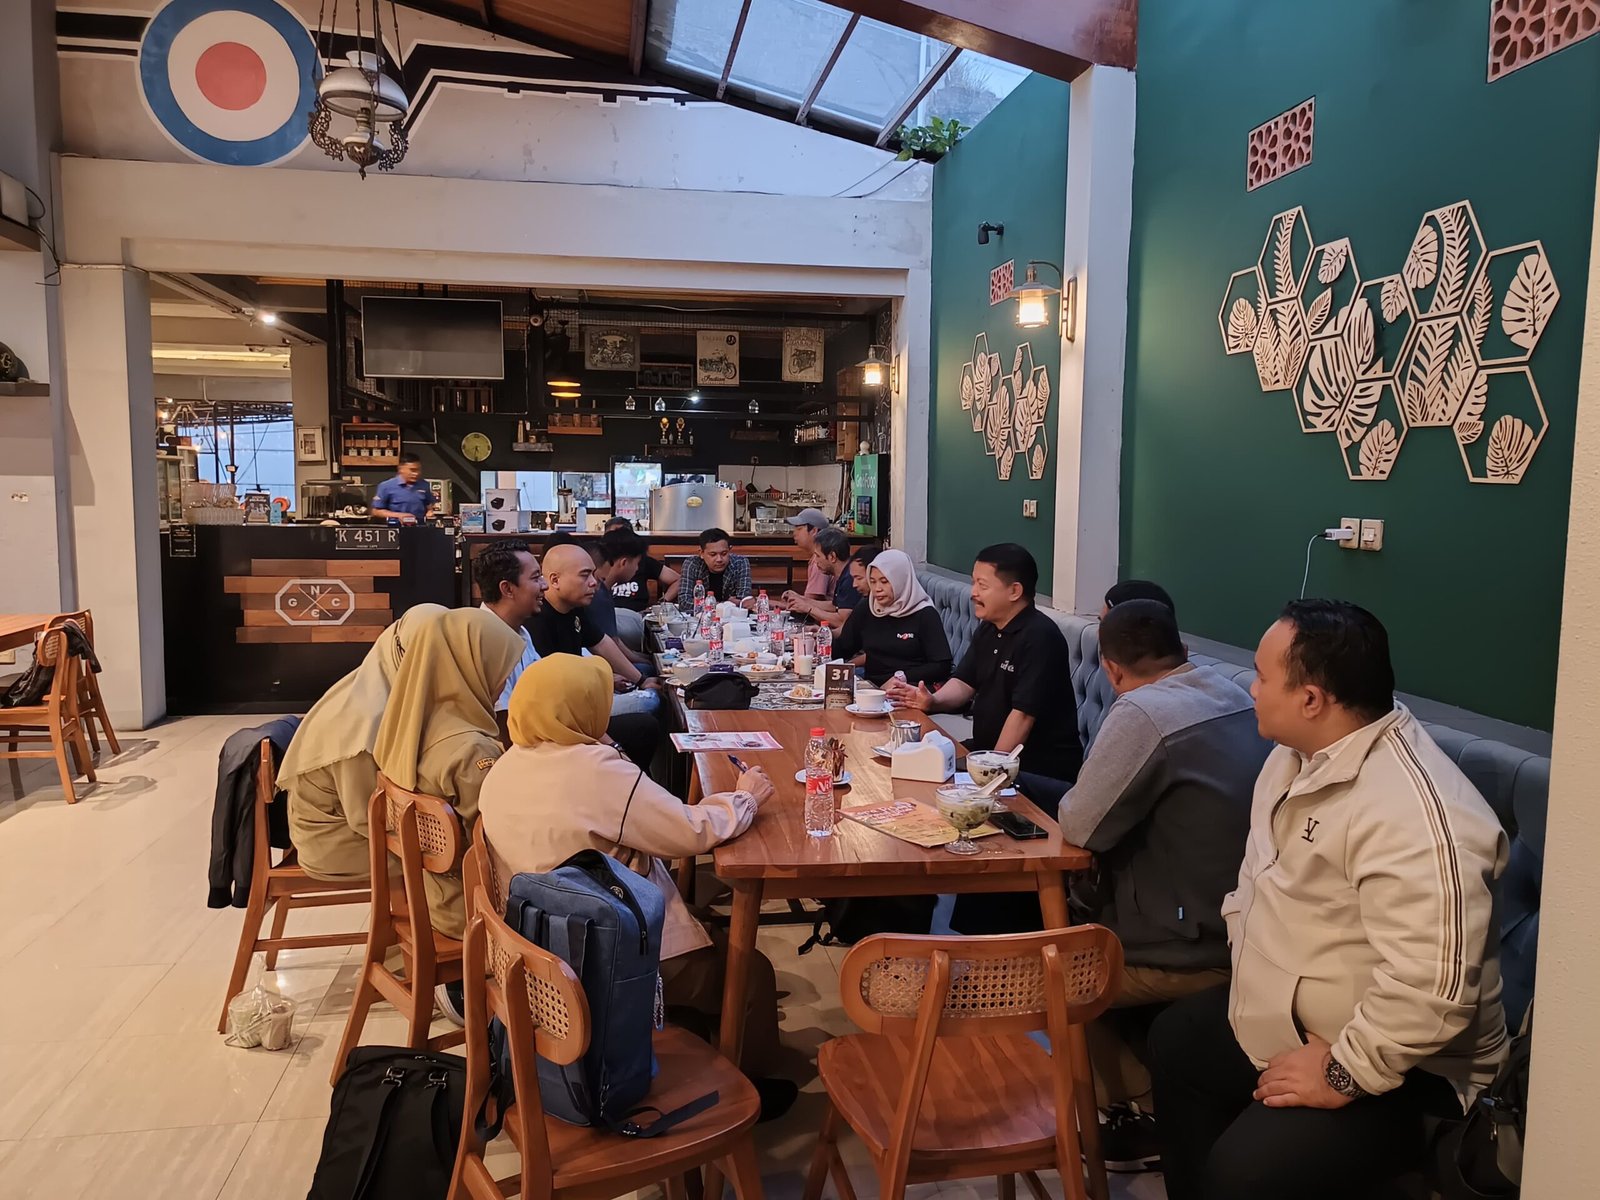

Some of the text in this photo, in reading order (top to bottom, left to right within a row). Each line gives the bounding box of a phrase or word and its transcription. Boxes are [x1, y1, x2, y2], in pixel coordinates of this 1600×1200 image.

[339, 530, 396, 542] K 451 R
[310, 585, 320, 595] N
[288, 598, 340, 607] G C
[831, 668, 850, 681] 31
